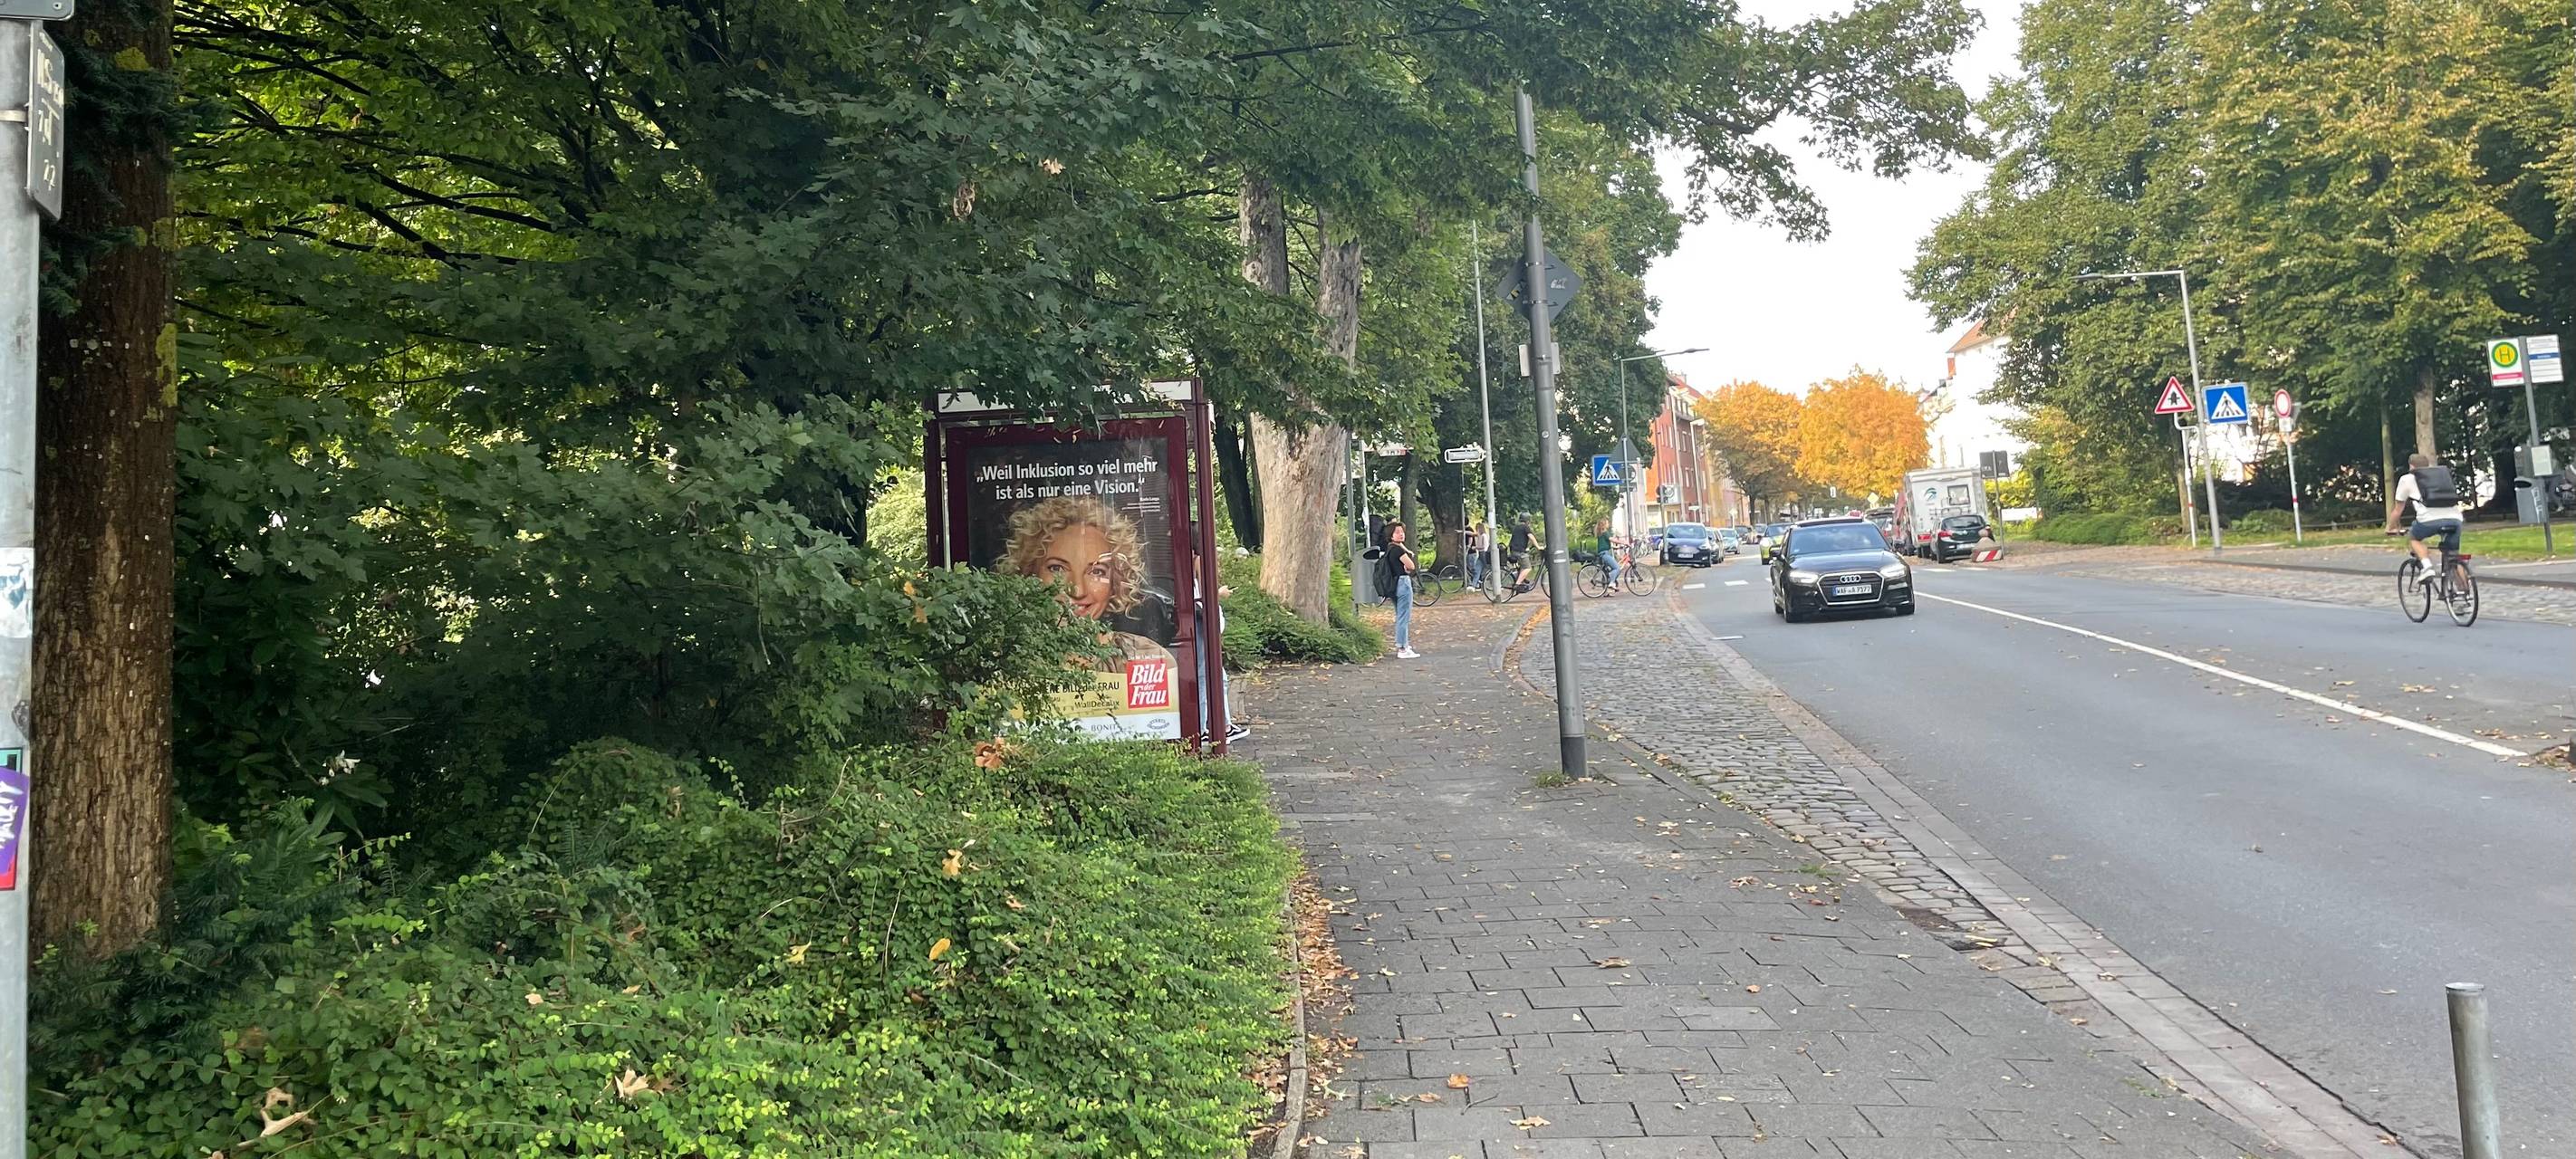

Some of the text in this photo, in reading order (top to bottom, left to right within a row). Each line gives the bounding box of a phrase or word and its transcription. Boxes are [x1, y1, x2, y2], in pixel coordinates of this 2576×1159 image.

[2499, 348, 2512, 362] H
[1016, 462, 1075, 479] Inklusion
[1078, 463, 1094, 476] so
[1097, 458, 1120, 474] viel
[1123, 456, 1158, 474] mehr
[995, 485, 1013, 500] ist
[1015, 484, 1034, 499] als
[1037, 484, 1061, 498] nur
[1063, 482, 1091, 496] eine
[1129, 663, 1167, 685] Bild
[1129, 685, 1167, 705] Frau
[1143, 683, 1156, 691] der
